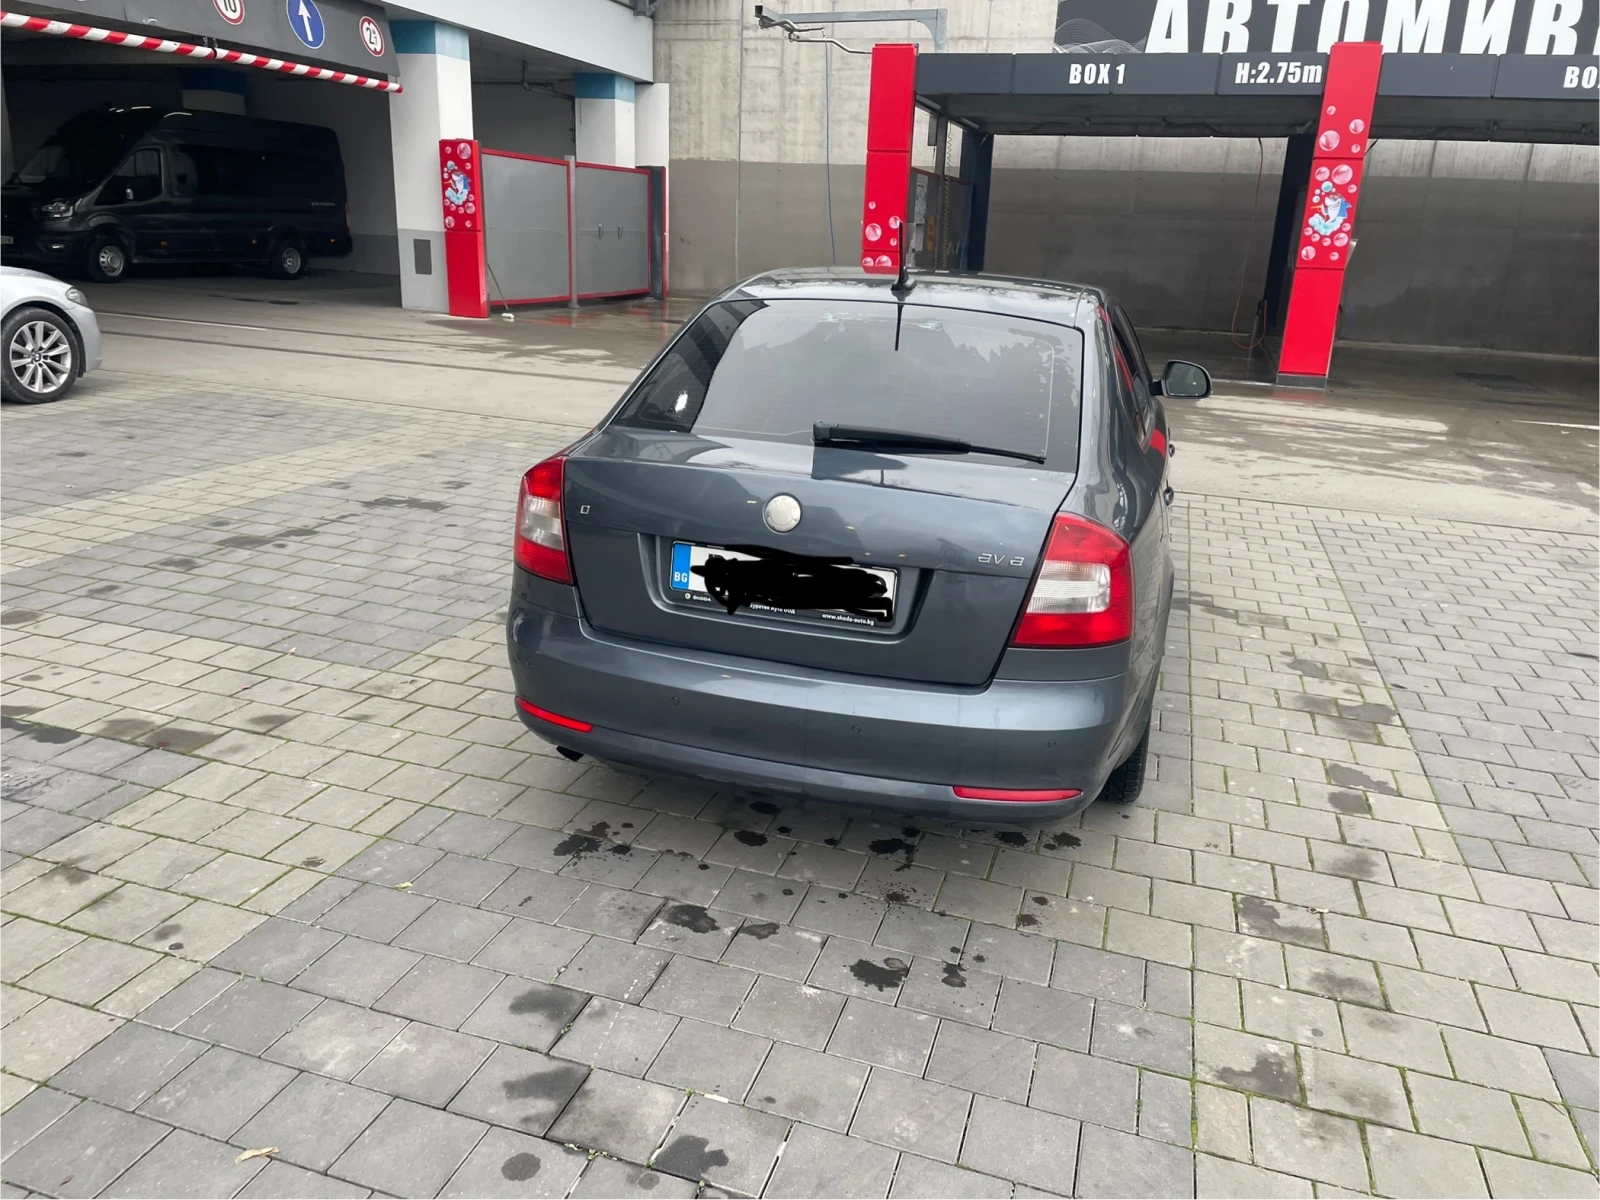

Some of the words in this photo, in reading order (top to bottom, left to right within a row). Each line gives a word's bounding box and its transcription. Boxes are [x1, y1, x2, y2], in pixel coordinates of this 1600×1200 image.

[1145, 0, 1599, 55] АВТОМИВ
[1068, 63, 1111, 84] BOX
[1115, 63, 1126, 84] 1
[1235, 62, 1322, 84] H:2.75m
[1563, 65, 1599, 90] BO
[673, 571, 688, 583] BG
[821, 613, 874, 626] www.skoda-auto.bg
